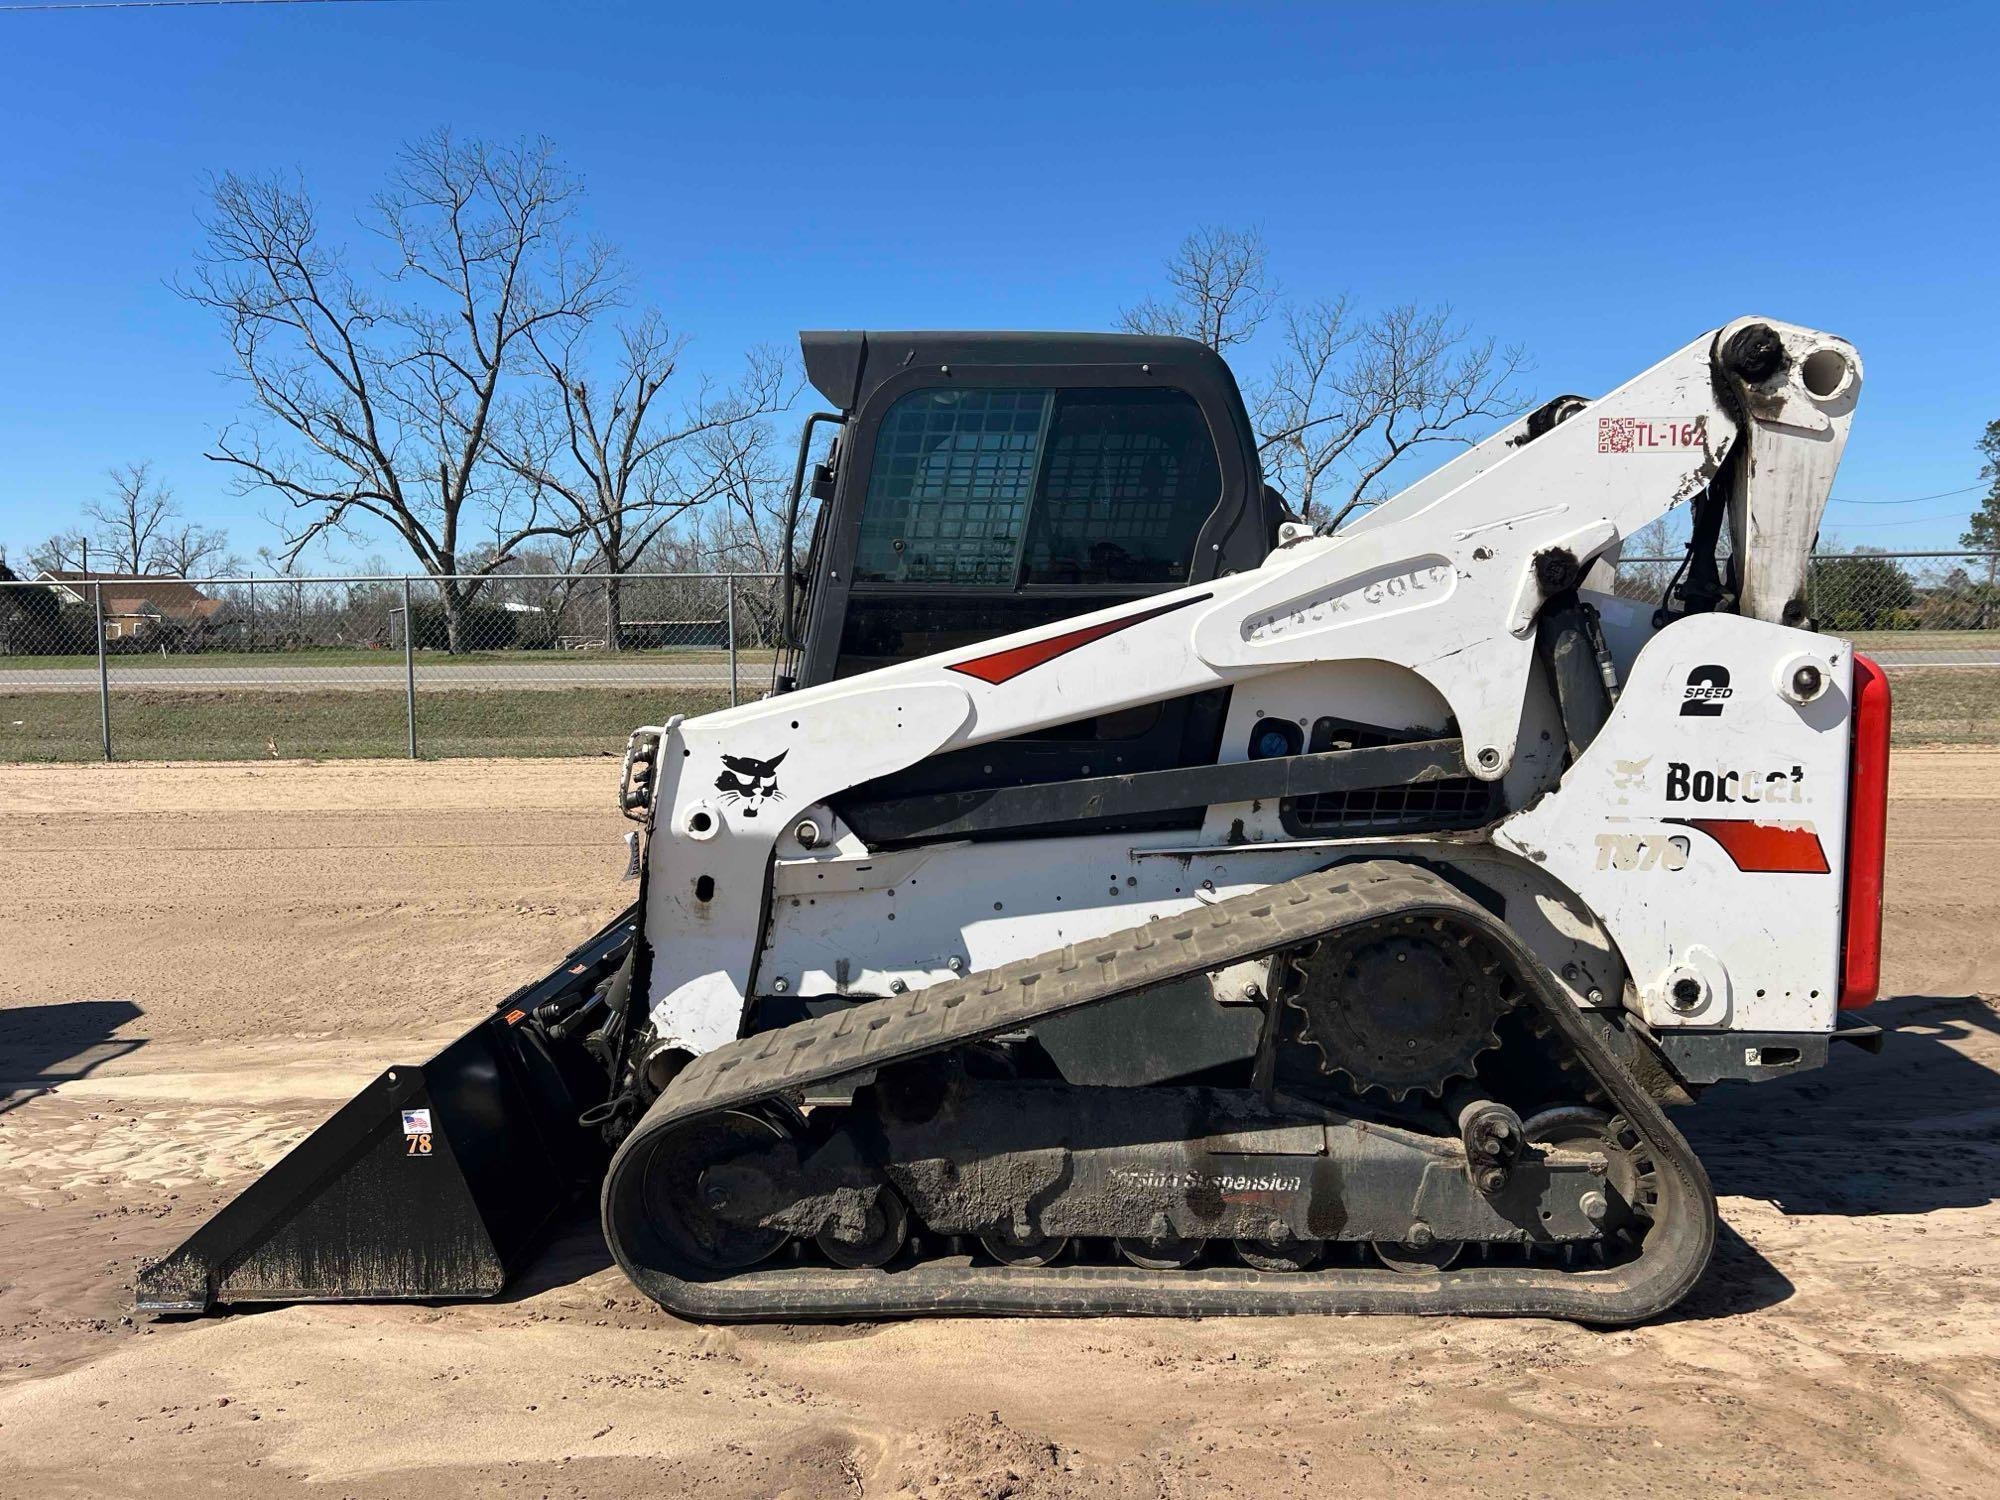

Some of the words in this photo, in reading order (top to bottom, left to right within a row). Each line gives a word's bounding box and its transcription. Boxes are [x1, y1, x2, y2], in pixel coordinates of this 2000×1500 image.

[1635, 424, 1706, 447] TL-162
[1683, 687, 1733, 699] SPEED
[406, 1134, 432, 1154] 78
